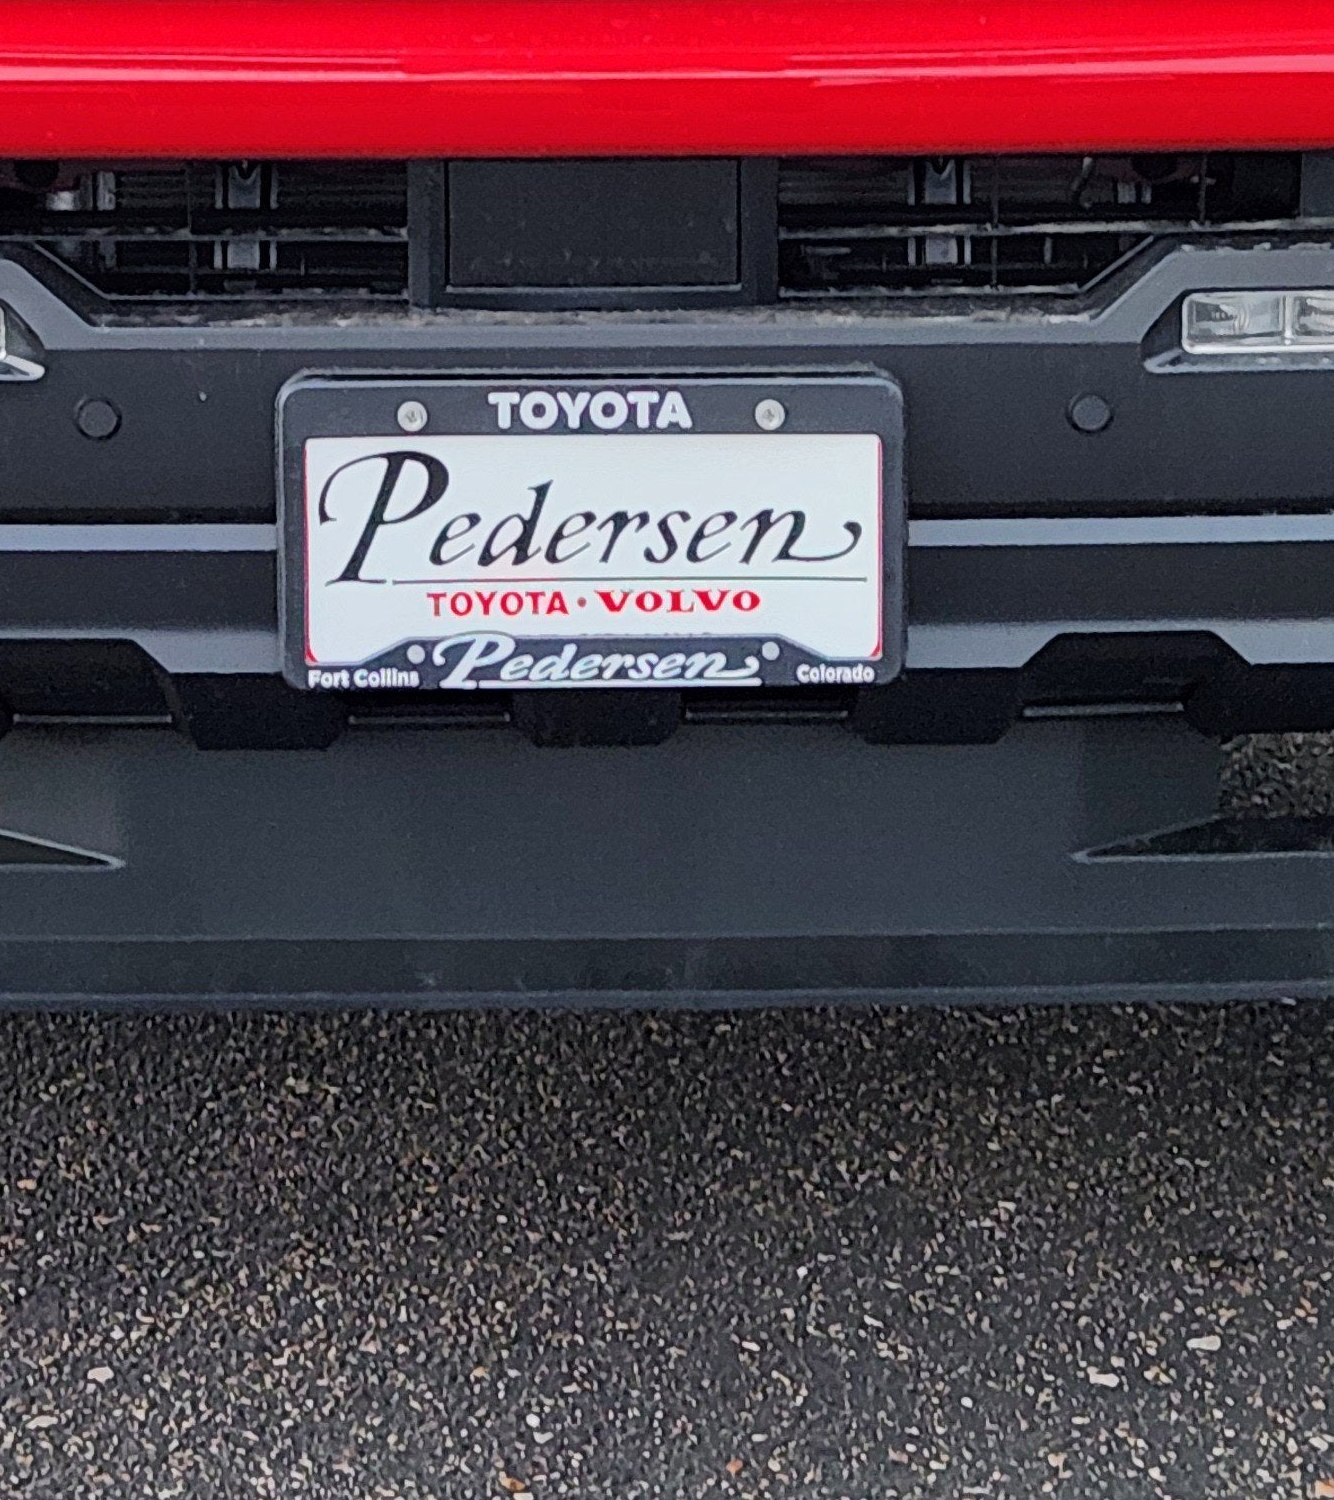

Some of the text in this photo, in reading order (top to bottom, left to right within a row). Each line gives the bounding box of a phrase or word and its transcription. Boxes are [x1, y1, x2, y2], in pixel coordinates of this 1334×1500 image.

[488, 391, 693, 429] TOYOTA
[318, 450, 864, 586] Pedersen
[426, 590, 761, 617] TOYOTA VOLVO
[432, 631, 761, 690] Pedersen
[796, 663, 875, 684] Colorado
[308, 668, 420, 689] Fort Collins
